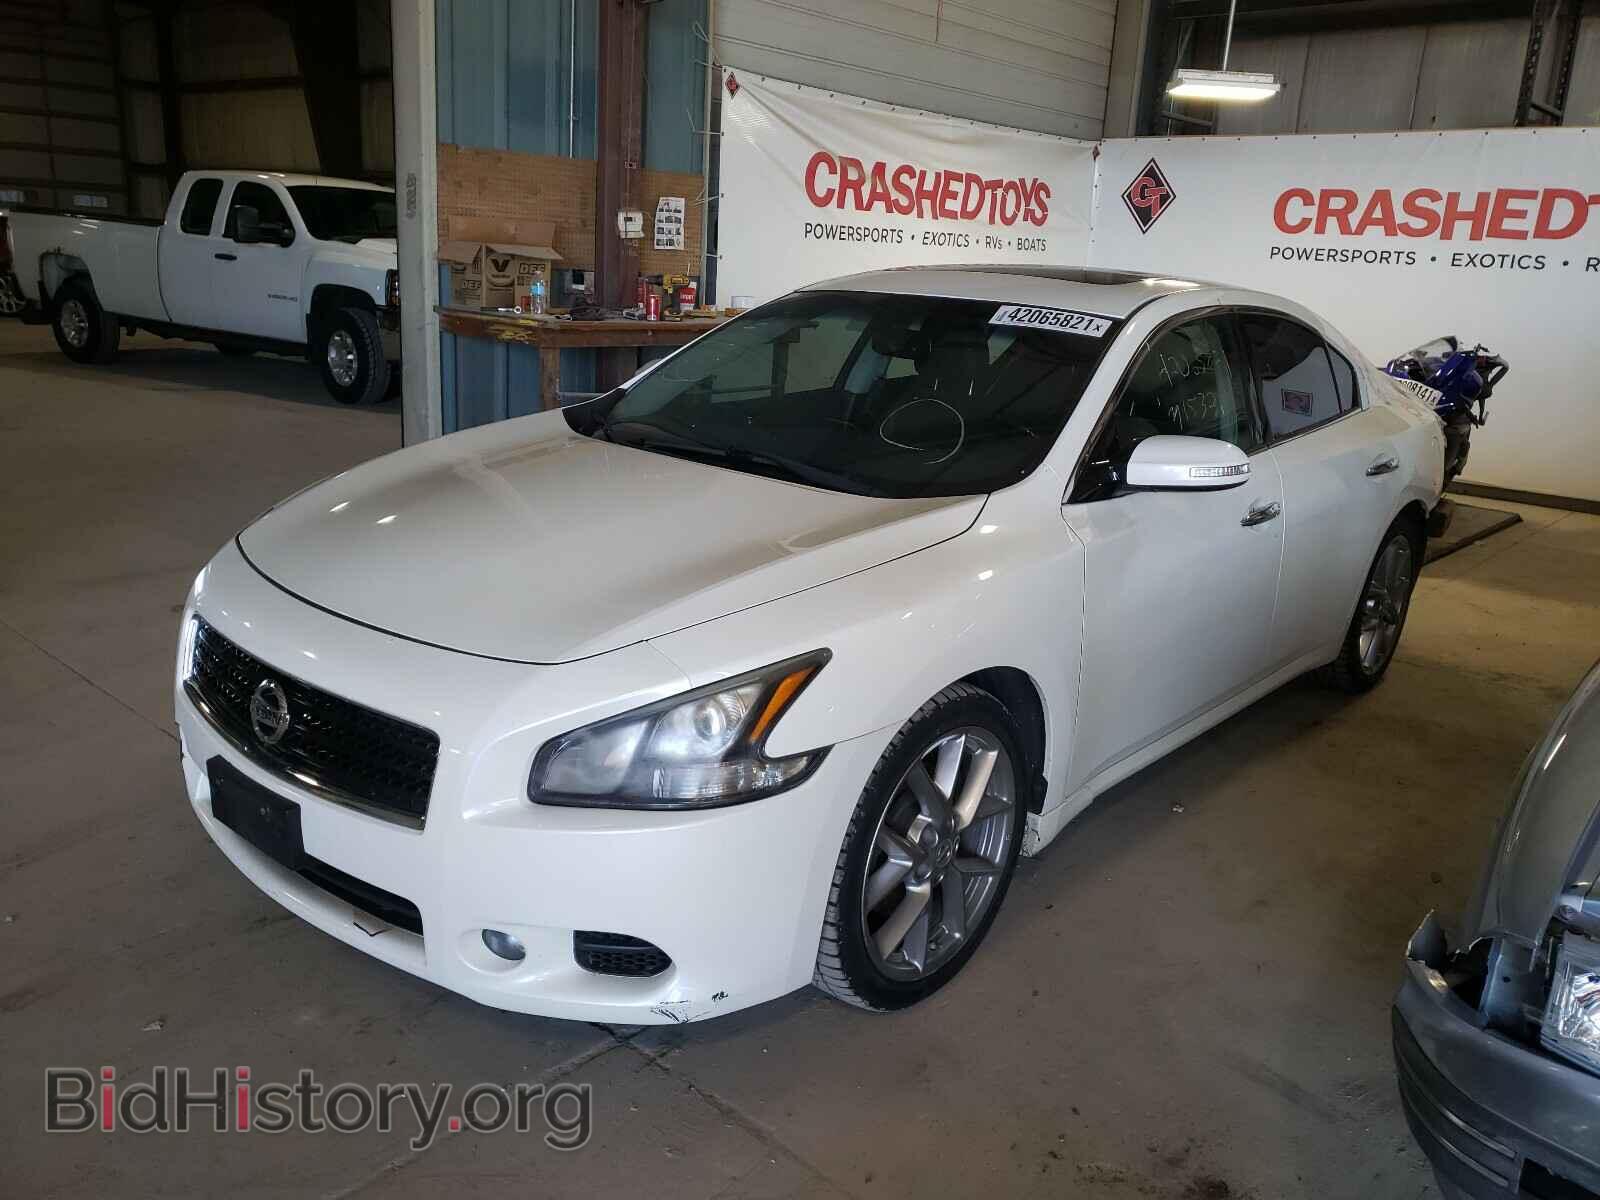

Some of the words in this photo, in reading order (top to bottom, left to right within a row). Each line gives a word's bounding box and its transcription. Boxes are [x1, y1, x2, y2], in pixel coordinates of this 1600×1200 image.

[804, 223, 903, 244] POWERSPORTS
[922, 231, 970, 248] EXOTICS
[985, 235, 1002, 250] RVs
[1016, 237, 1047, 252] BOATS
[1270, 246, 1417, 266] POWERSPORTS
[1450, 252, 1546, 270] EXOTICS
